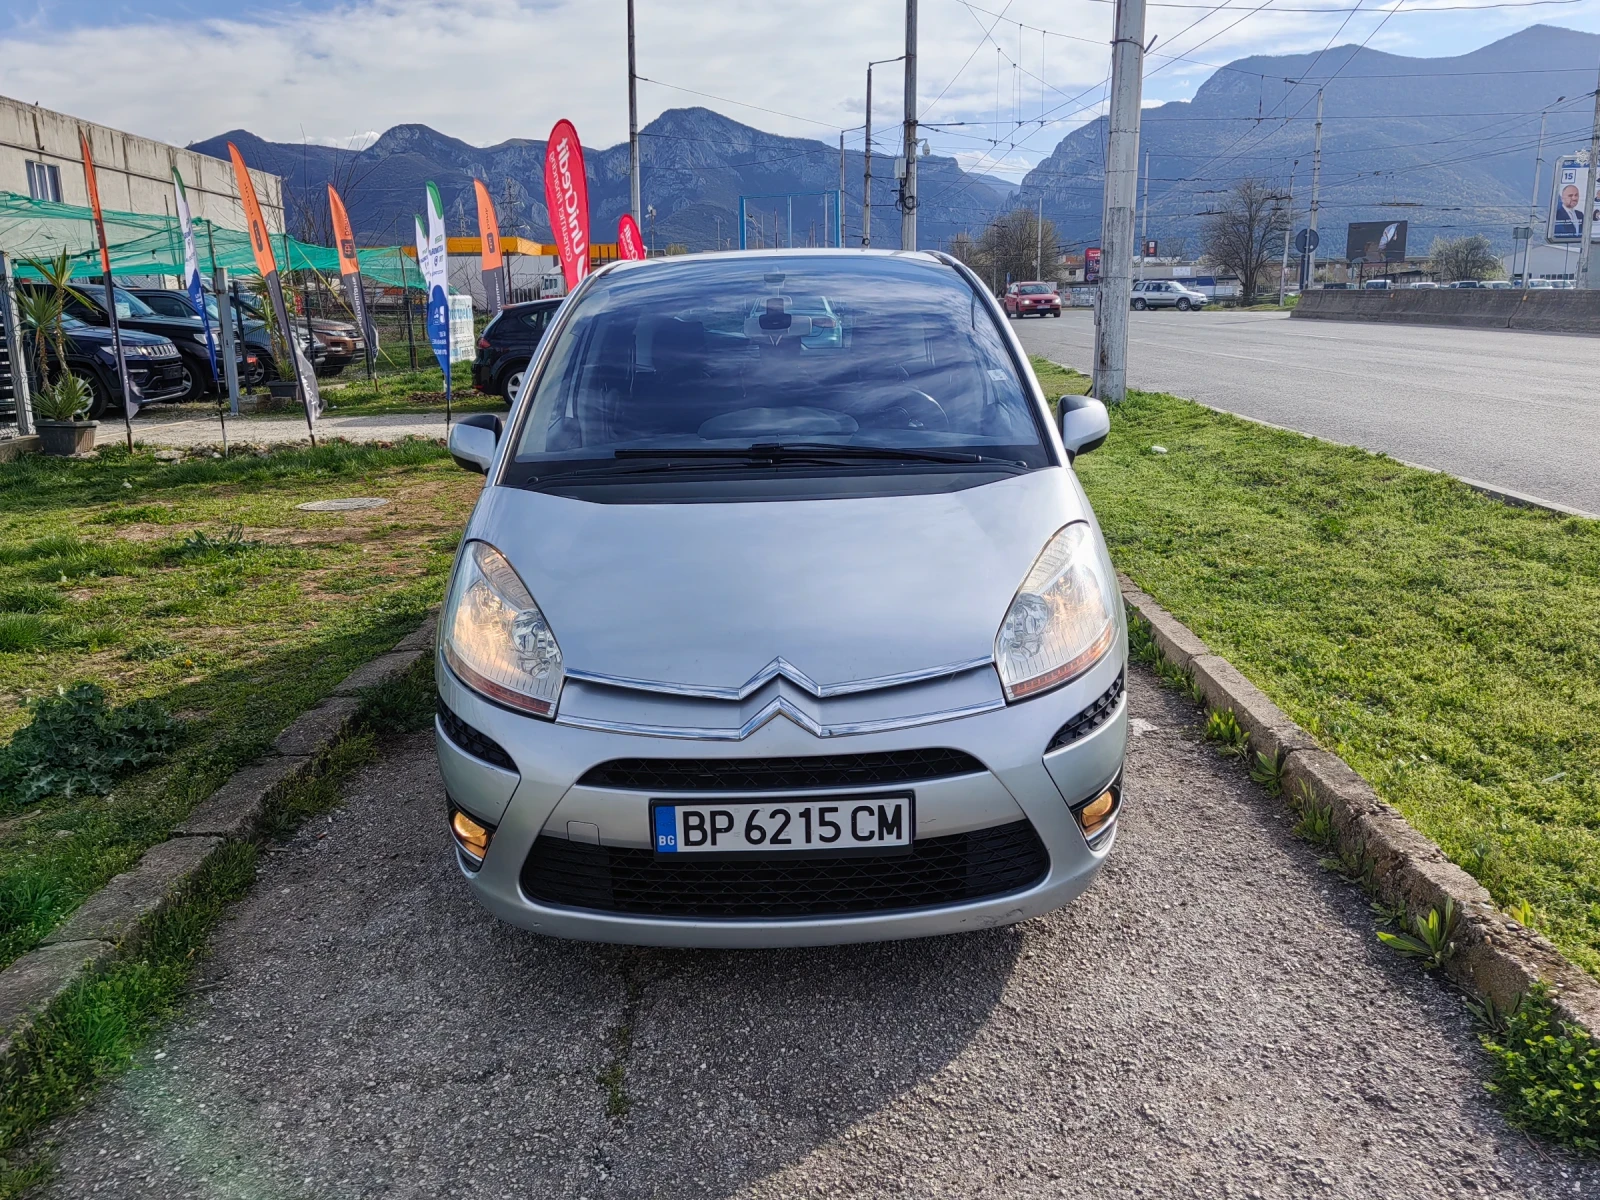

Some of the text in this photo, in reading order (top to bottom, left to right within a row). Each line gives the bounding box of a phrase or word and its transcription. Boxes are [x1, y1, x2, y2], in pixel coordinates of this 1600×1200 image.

[1564, 172, 1574, 180] 15
[682, 804, 902, 847] BP 6215 CM
[658, 835, 675, 846] BG
